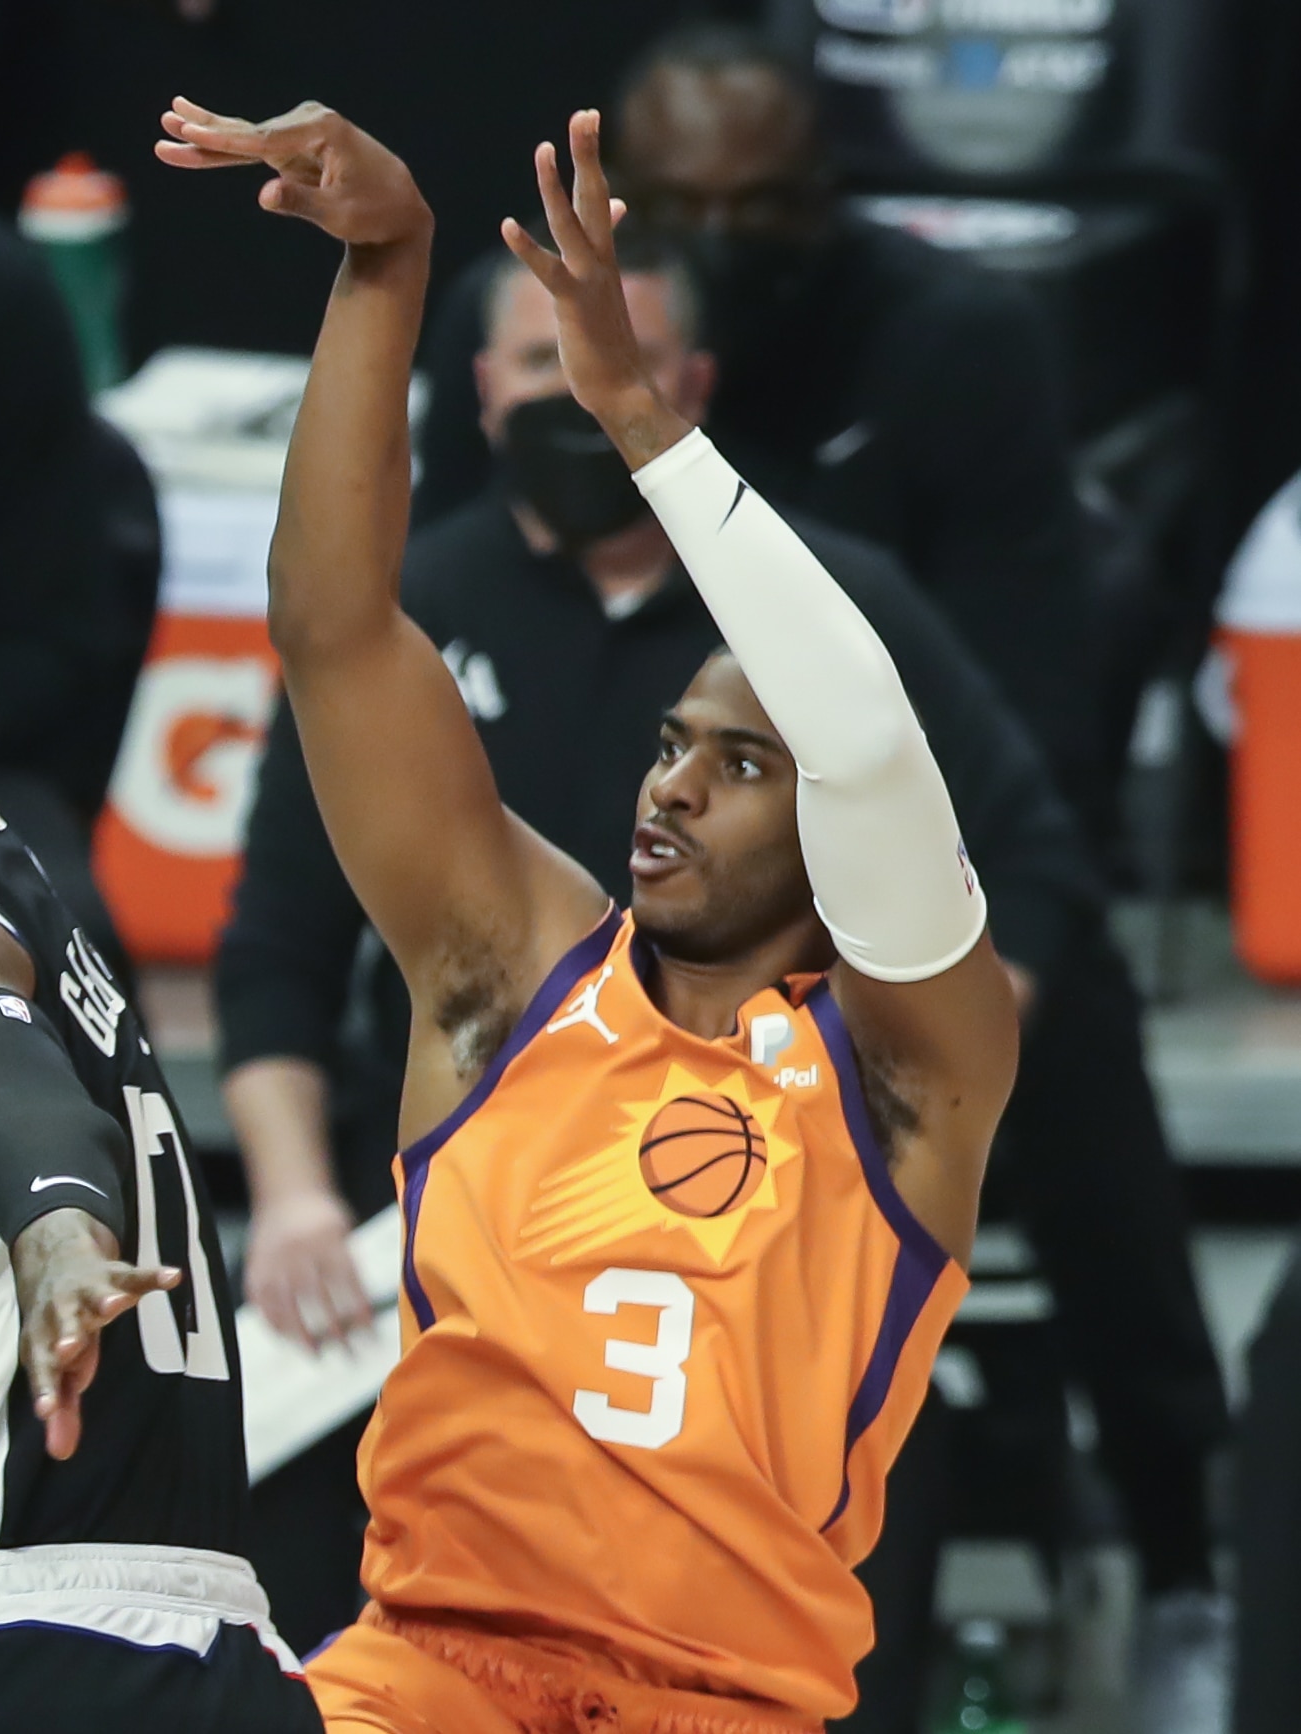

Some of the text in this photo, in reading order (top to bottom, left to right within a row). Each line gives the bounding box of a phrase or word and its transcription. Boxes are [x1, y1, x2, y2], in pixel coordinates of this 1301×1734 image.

[105, 658, 275, 857] G
[773, 1063, 818, 1089] Pal
[573, 1266, 695, 1449] 3
